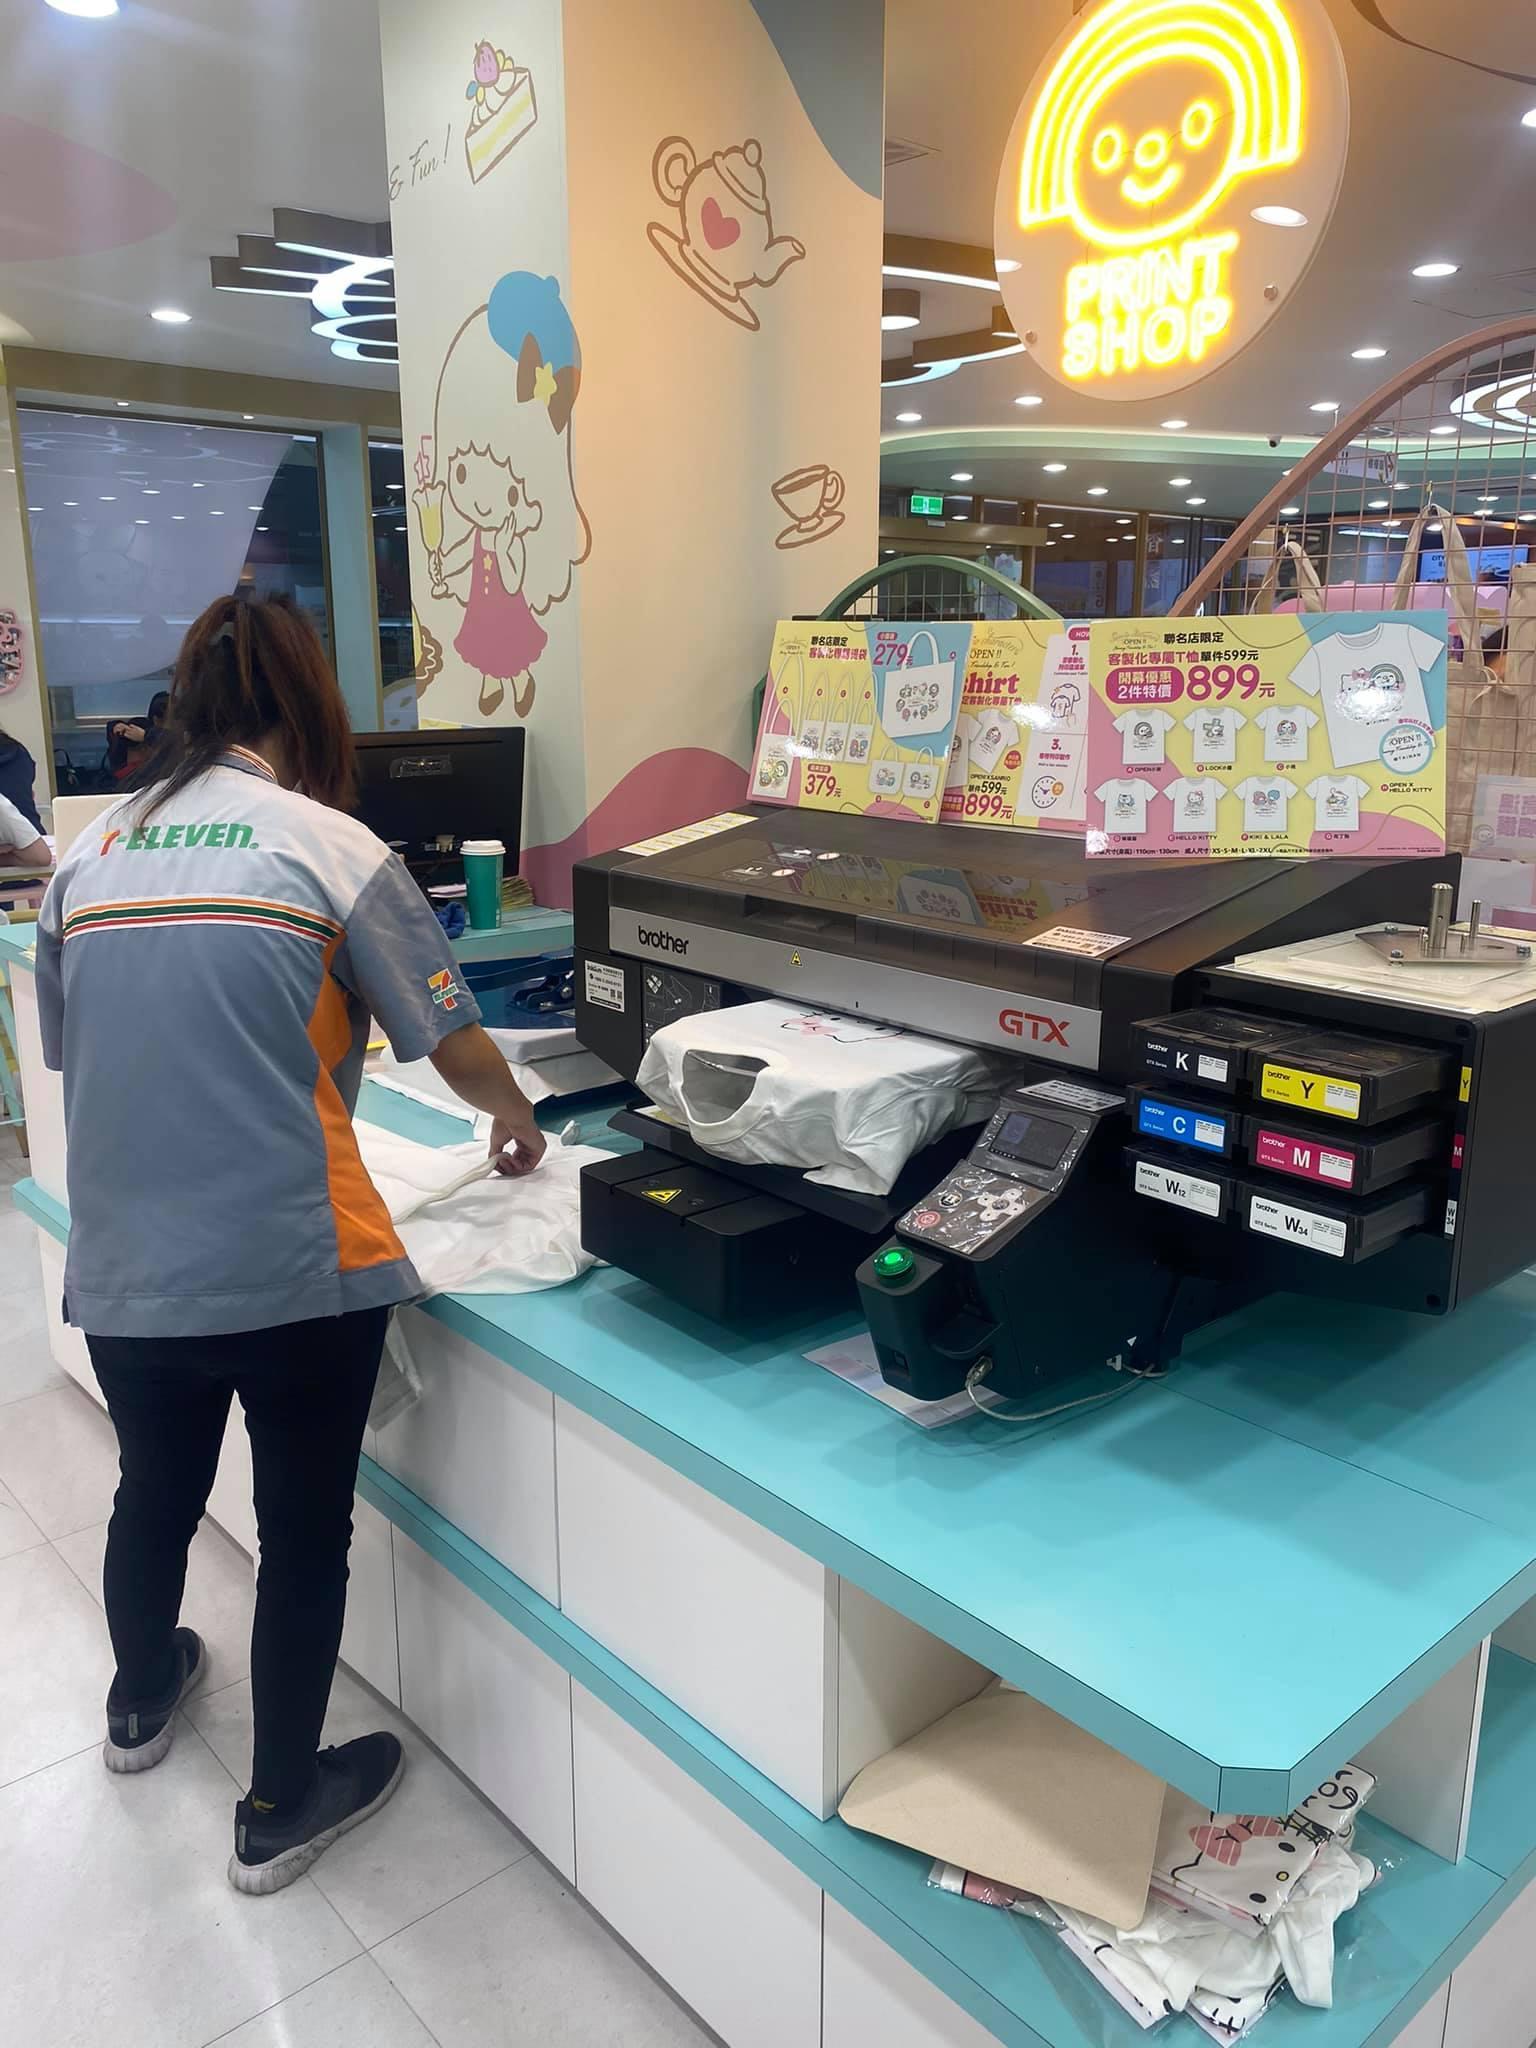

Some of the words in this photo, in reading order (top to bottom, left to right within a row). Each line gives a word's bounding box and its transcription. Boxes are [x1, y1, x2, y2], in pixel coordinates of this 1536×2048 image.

[1066, 231, 1240, 323] PRINT
[1061, 297, 1232, 379] SHOP
[1163, 631, 1224, 645] 聯名店限定
[1117, 671, 1172, 685] 開幕優惠
[1117, 684, 1172, 699] 2件特價
[638, 925, 689, 955] brother
[999, 1009, 1070, 1048] GTX
[1147, 1041, 1168, 1053] brother
[1175, 1051, 1189, 1071] K
[1267, 1070, 1291, 1081] brother
[1300, 1080, 1315, 1099] Y
[1462, 1080, 1469, 1089] Y
[1144, 1105, 1165, 1116] brother
[1172, 1116, 1186, 1134] C
[1262, 1136, 1286, 1148] brother
[1292, 1147, 1311, 1169] M
[1453, 1146, 1463, 1157] M
[1139, 1167, 1160, 1178] brother
[1255, 1202, 1279, 1214] brother
[1447, 1207, 1456, 1217] W
